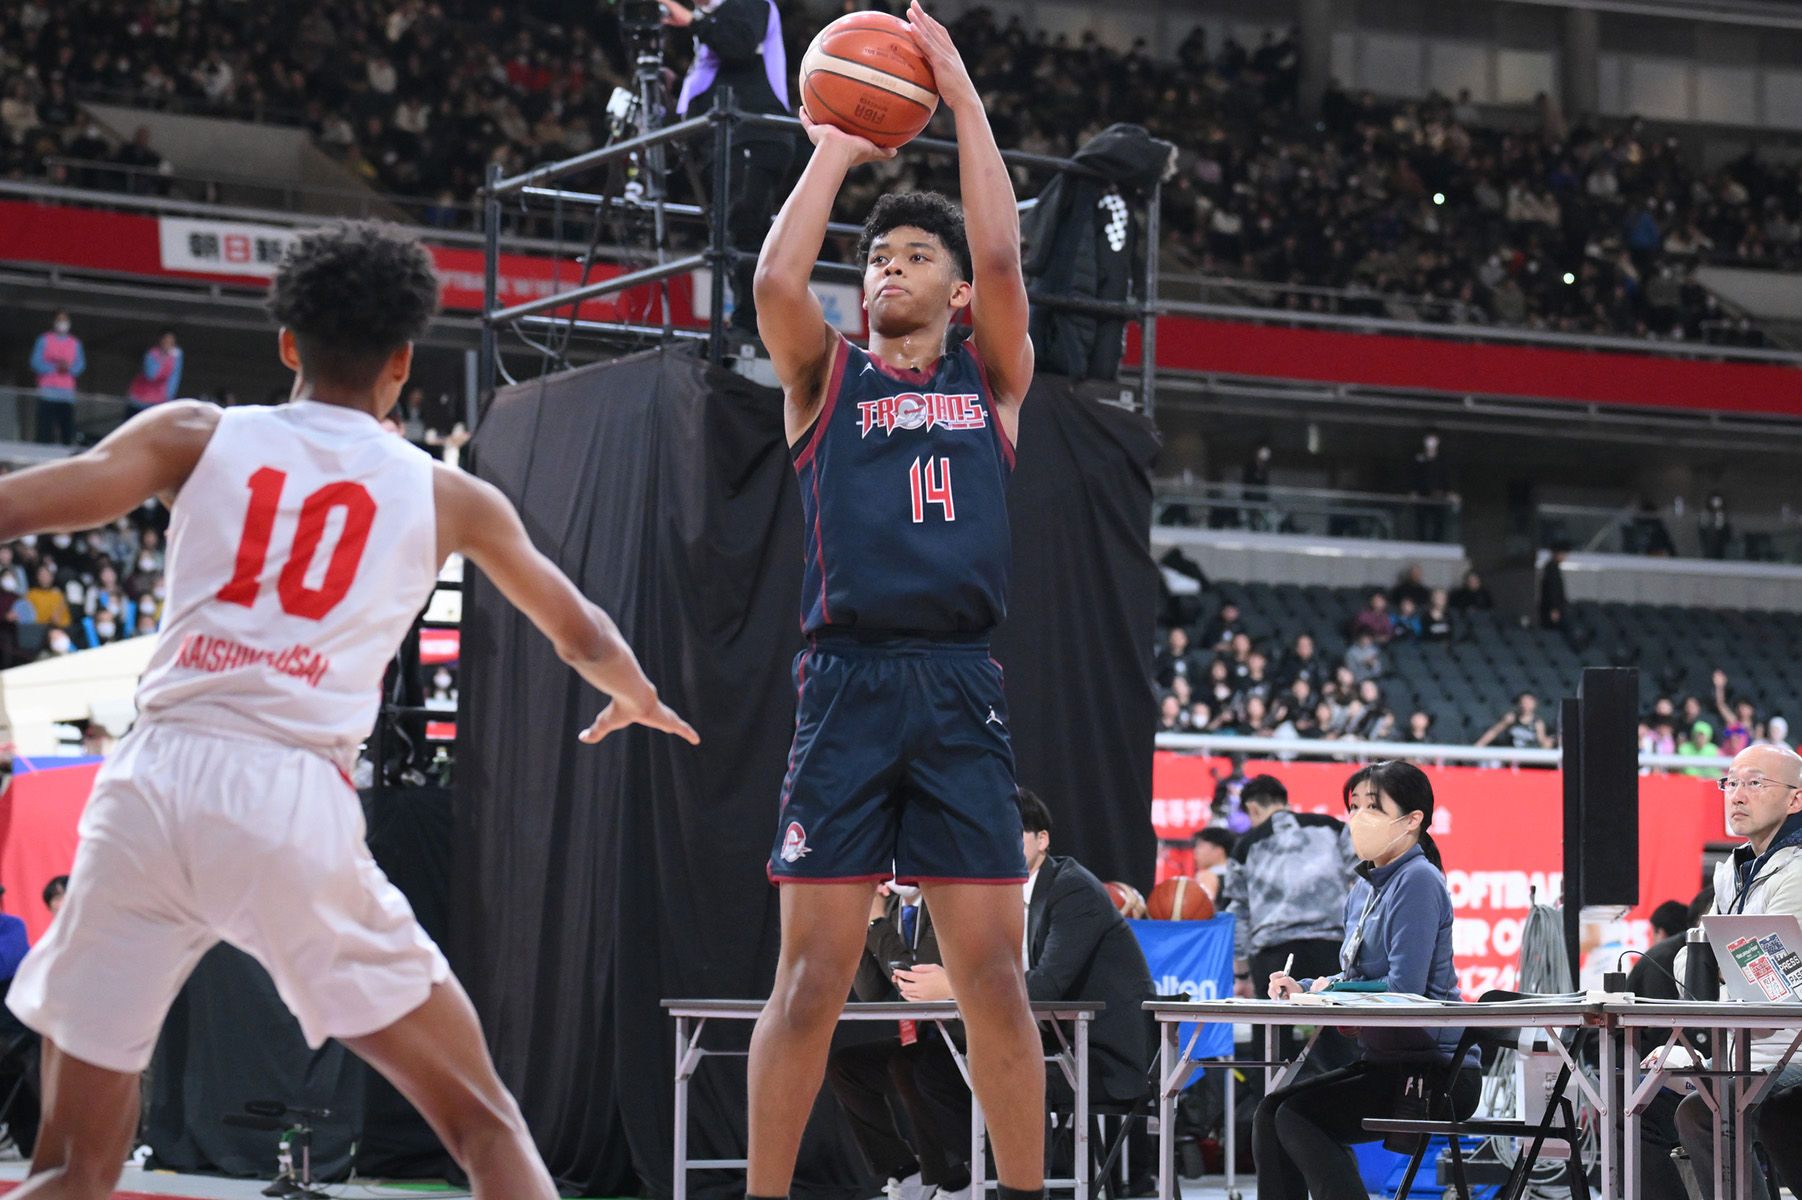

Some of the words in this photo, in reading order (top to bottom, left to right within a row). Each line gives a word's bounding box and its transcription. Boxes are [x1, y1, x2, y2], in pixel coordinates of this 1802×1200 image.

[854, 104, 886, 125] FIBA
[188, 231, 290, 263] 朝日新
[857, 392, 987, 439] TROJANS
[909, 455, 956, 524] 14
[216, 465, 378, 621] 10
[1452, 917, 1491, 957] ER
[1779, 955, 1801, 972] PRESS
